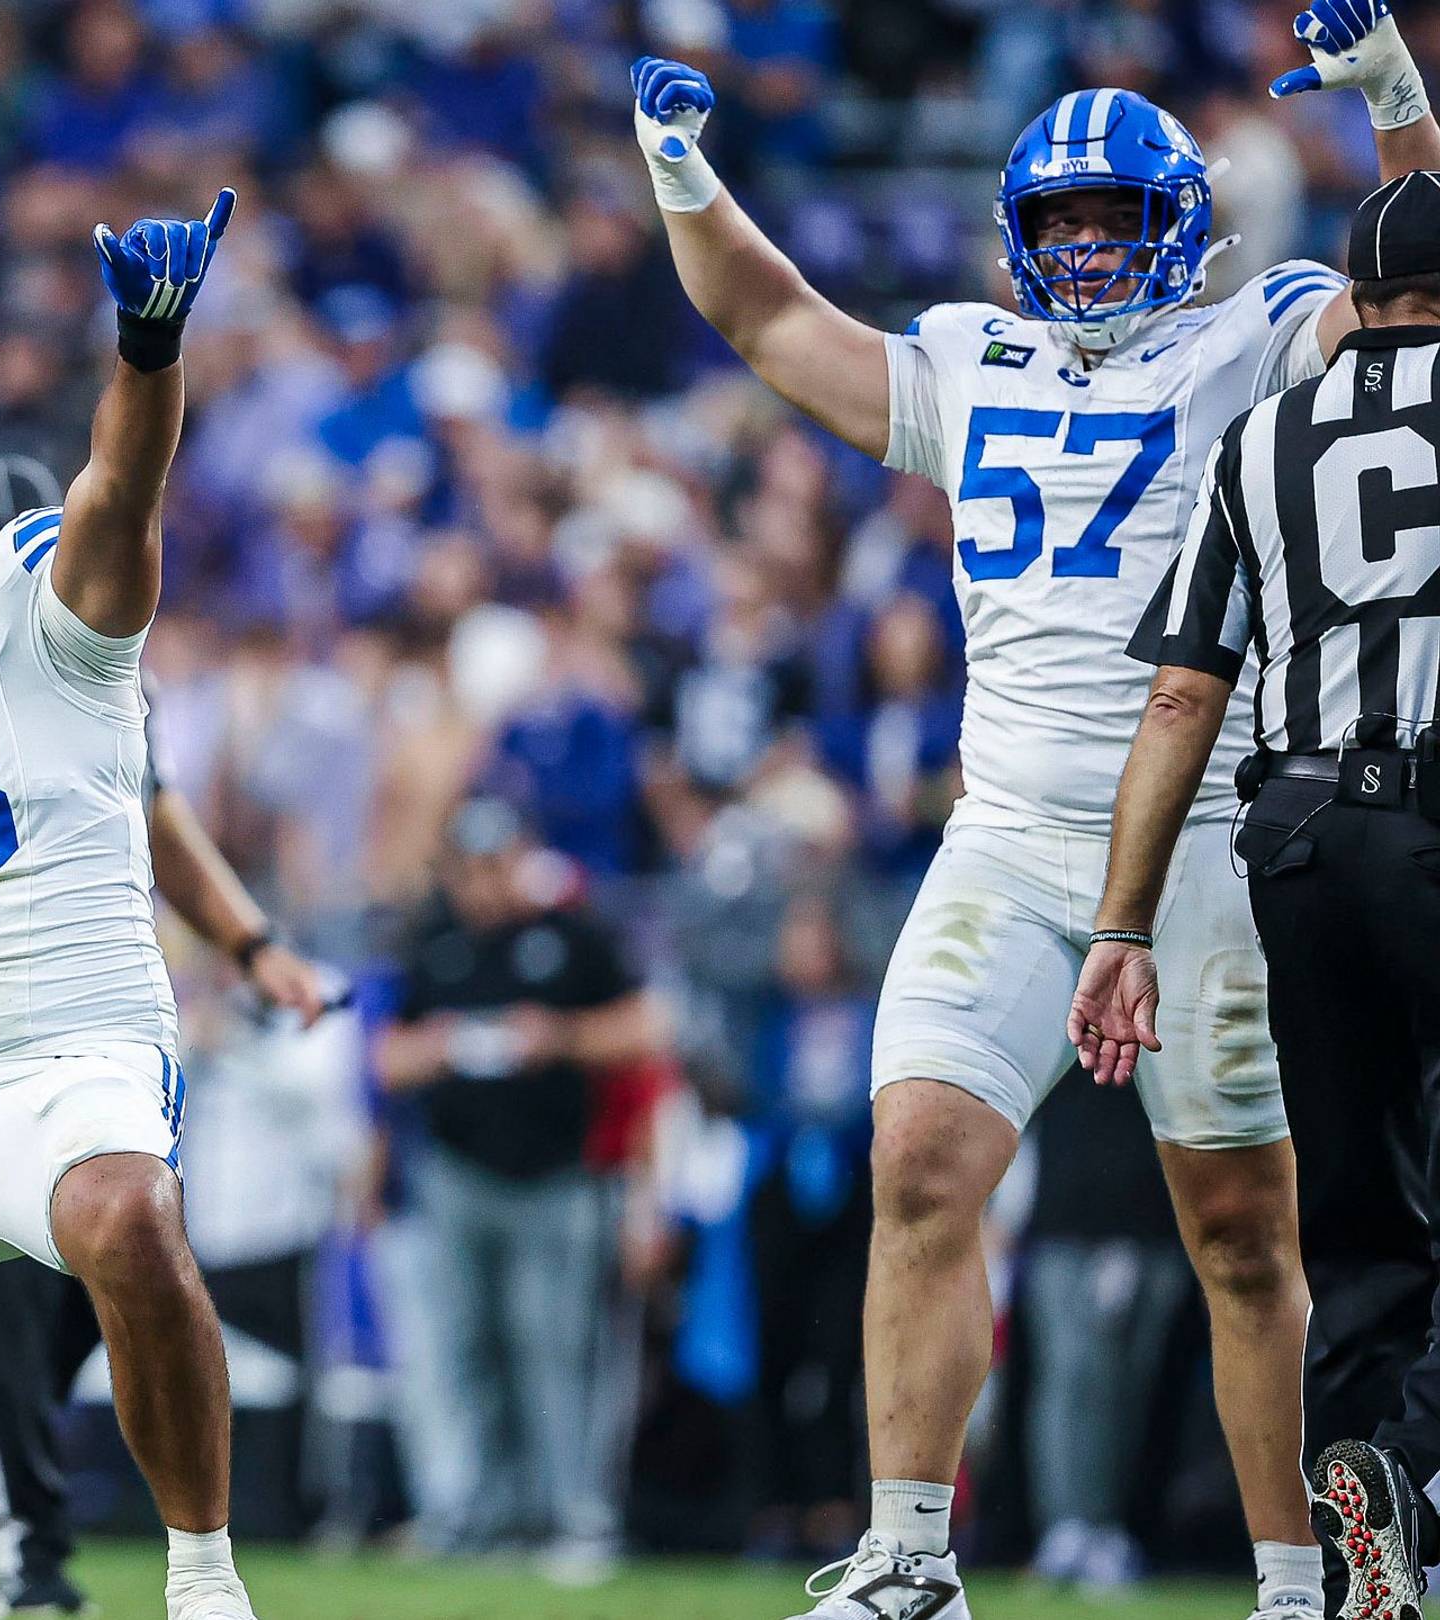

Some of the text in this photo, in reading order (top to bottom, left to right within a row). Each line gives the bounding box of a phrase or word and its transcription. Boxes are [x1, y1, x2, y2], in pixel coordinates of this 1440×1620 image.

[1061, 160, 1089, 172] BYU
[956, 406, 1176, 582] 57
[1313, 425, 1440, 607] C
[1361, 764, 1381, 794] S
[1272, 1596, 1312, 1607] ALPHA
